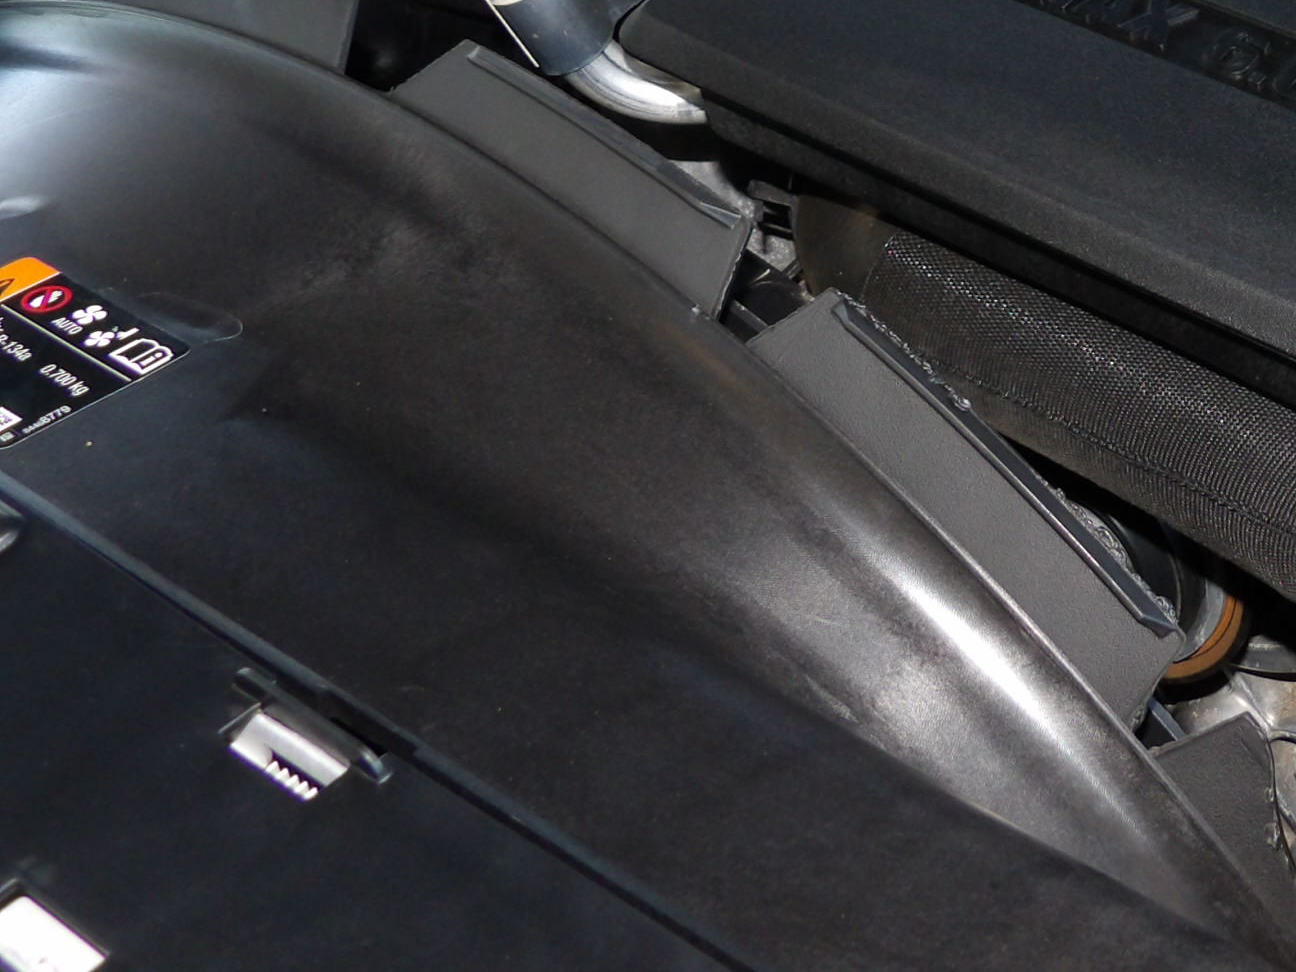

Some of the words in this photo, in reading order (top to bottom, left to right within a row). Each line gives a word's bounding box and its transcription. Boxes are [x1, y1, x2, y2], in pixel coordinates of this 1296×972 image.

[52, 317, 82, 335] AUTO
[39, 364, 77, 386] 0.700
[69, 380, 90, 397] kg
